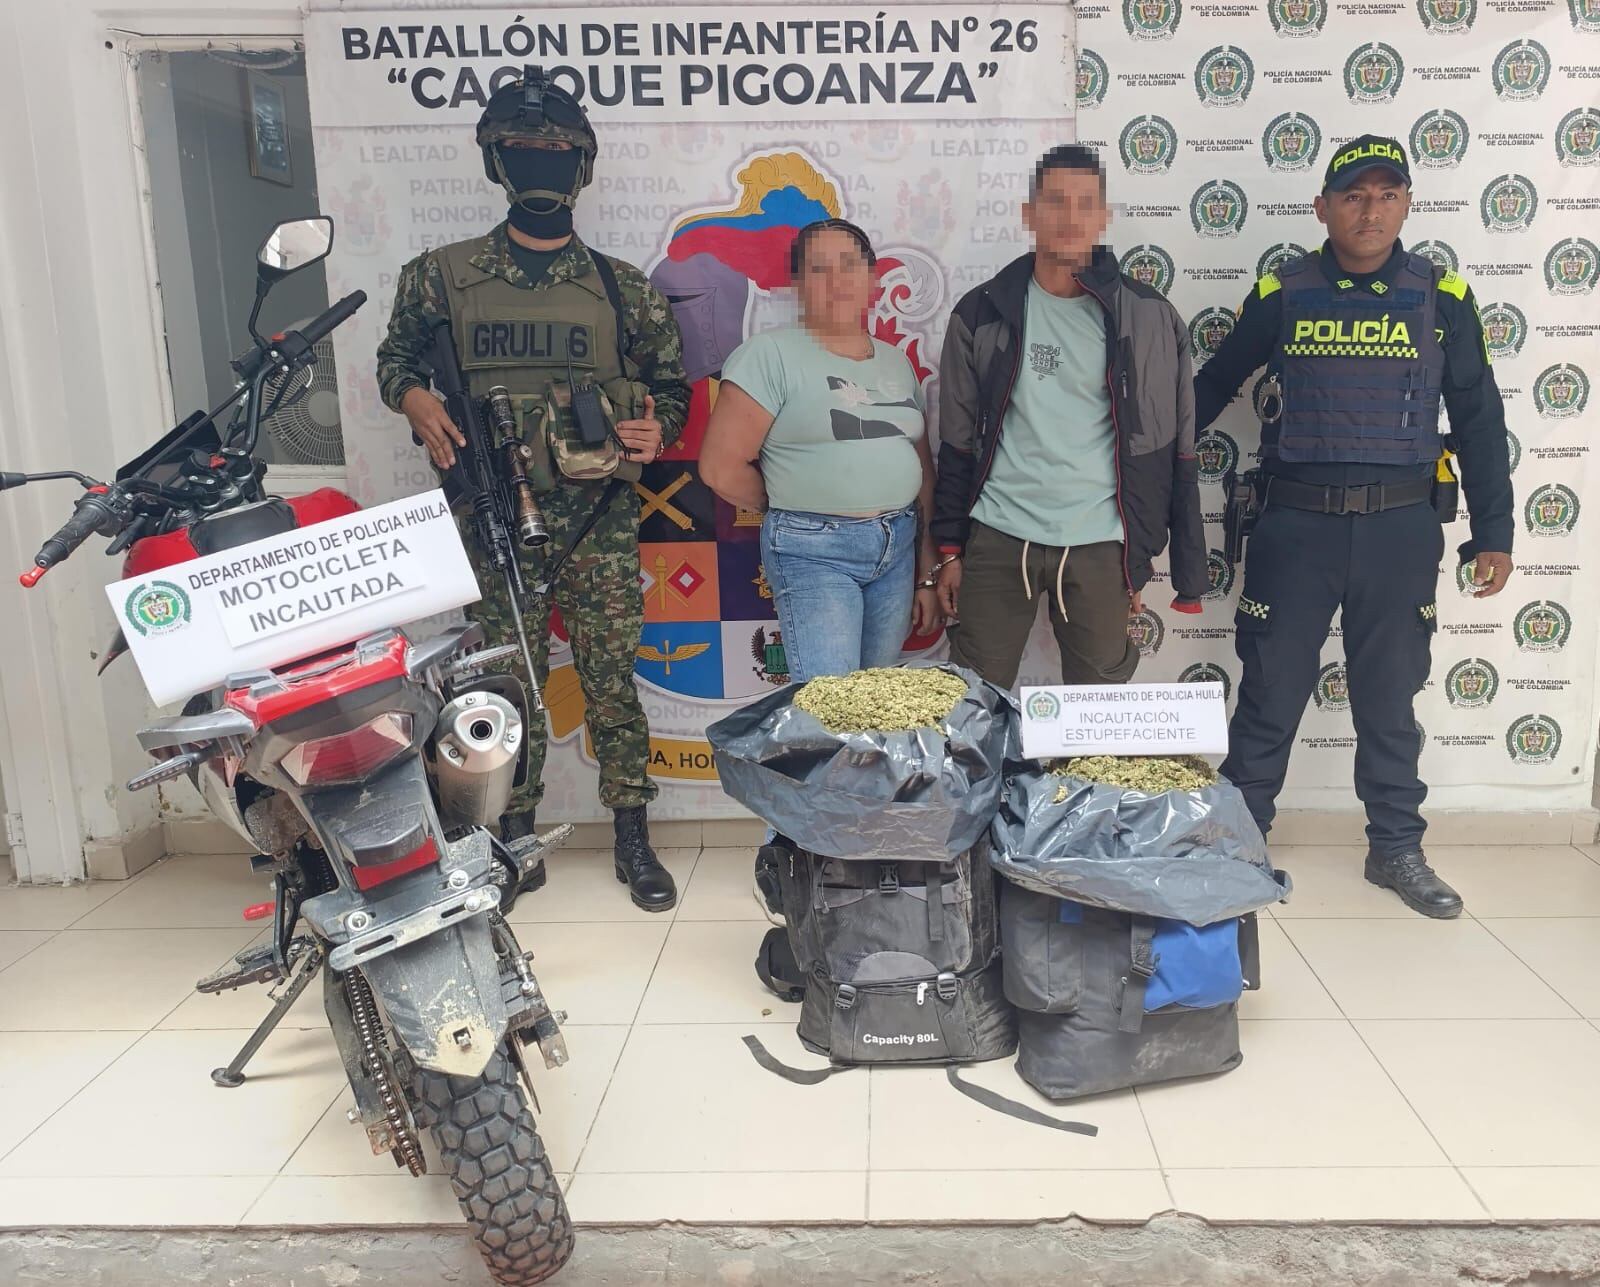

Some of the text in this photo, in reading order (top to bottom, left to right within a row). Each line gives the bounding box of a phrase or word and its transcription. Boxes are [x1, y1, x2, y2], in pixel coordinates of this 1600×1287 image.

[342, 15, 567, 60] BATALLÓN
[581, 23, 640, 57] DE
[653, 12, 920, 56] INFANTERÍA
[989, 19, 1038, 52] 26
[681, 62, 999, 106] PIGOANZA”
[359, 144, 458, 163] LEALTAD
[930, 138, 1029, 157] LEALTAD
[1334, 143, 1403, 172] POLICÍA
[598, 176, 686, 194] PATRIA,
[474, 323, 588, 358] GRULI 6
[1294, 314, 1411, 344] POLICÍA
[188, 501, 449, 590] DEPARTAMENTO DE POLICIA HUILA
[219, 538, 411, 609] MOTOCICLETA
[249, 571, 404, 633] INCAUTADA
[1063, 689, 1224, 703] DEPARTAMENTO DE POLICIA HUILA
[1080, 708, 1180, 724] INCAUTACIÓN
[1065, 728, 1196, 741] ESTUPEFACIENTE
[862, 1033, 938, 1046] Capacity 80L
